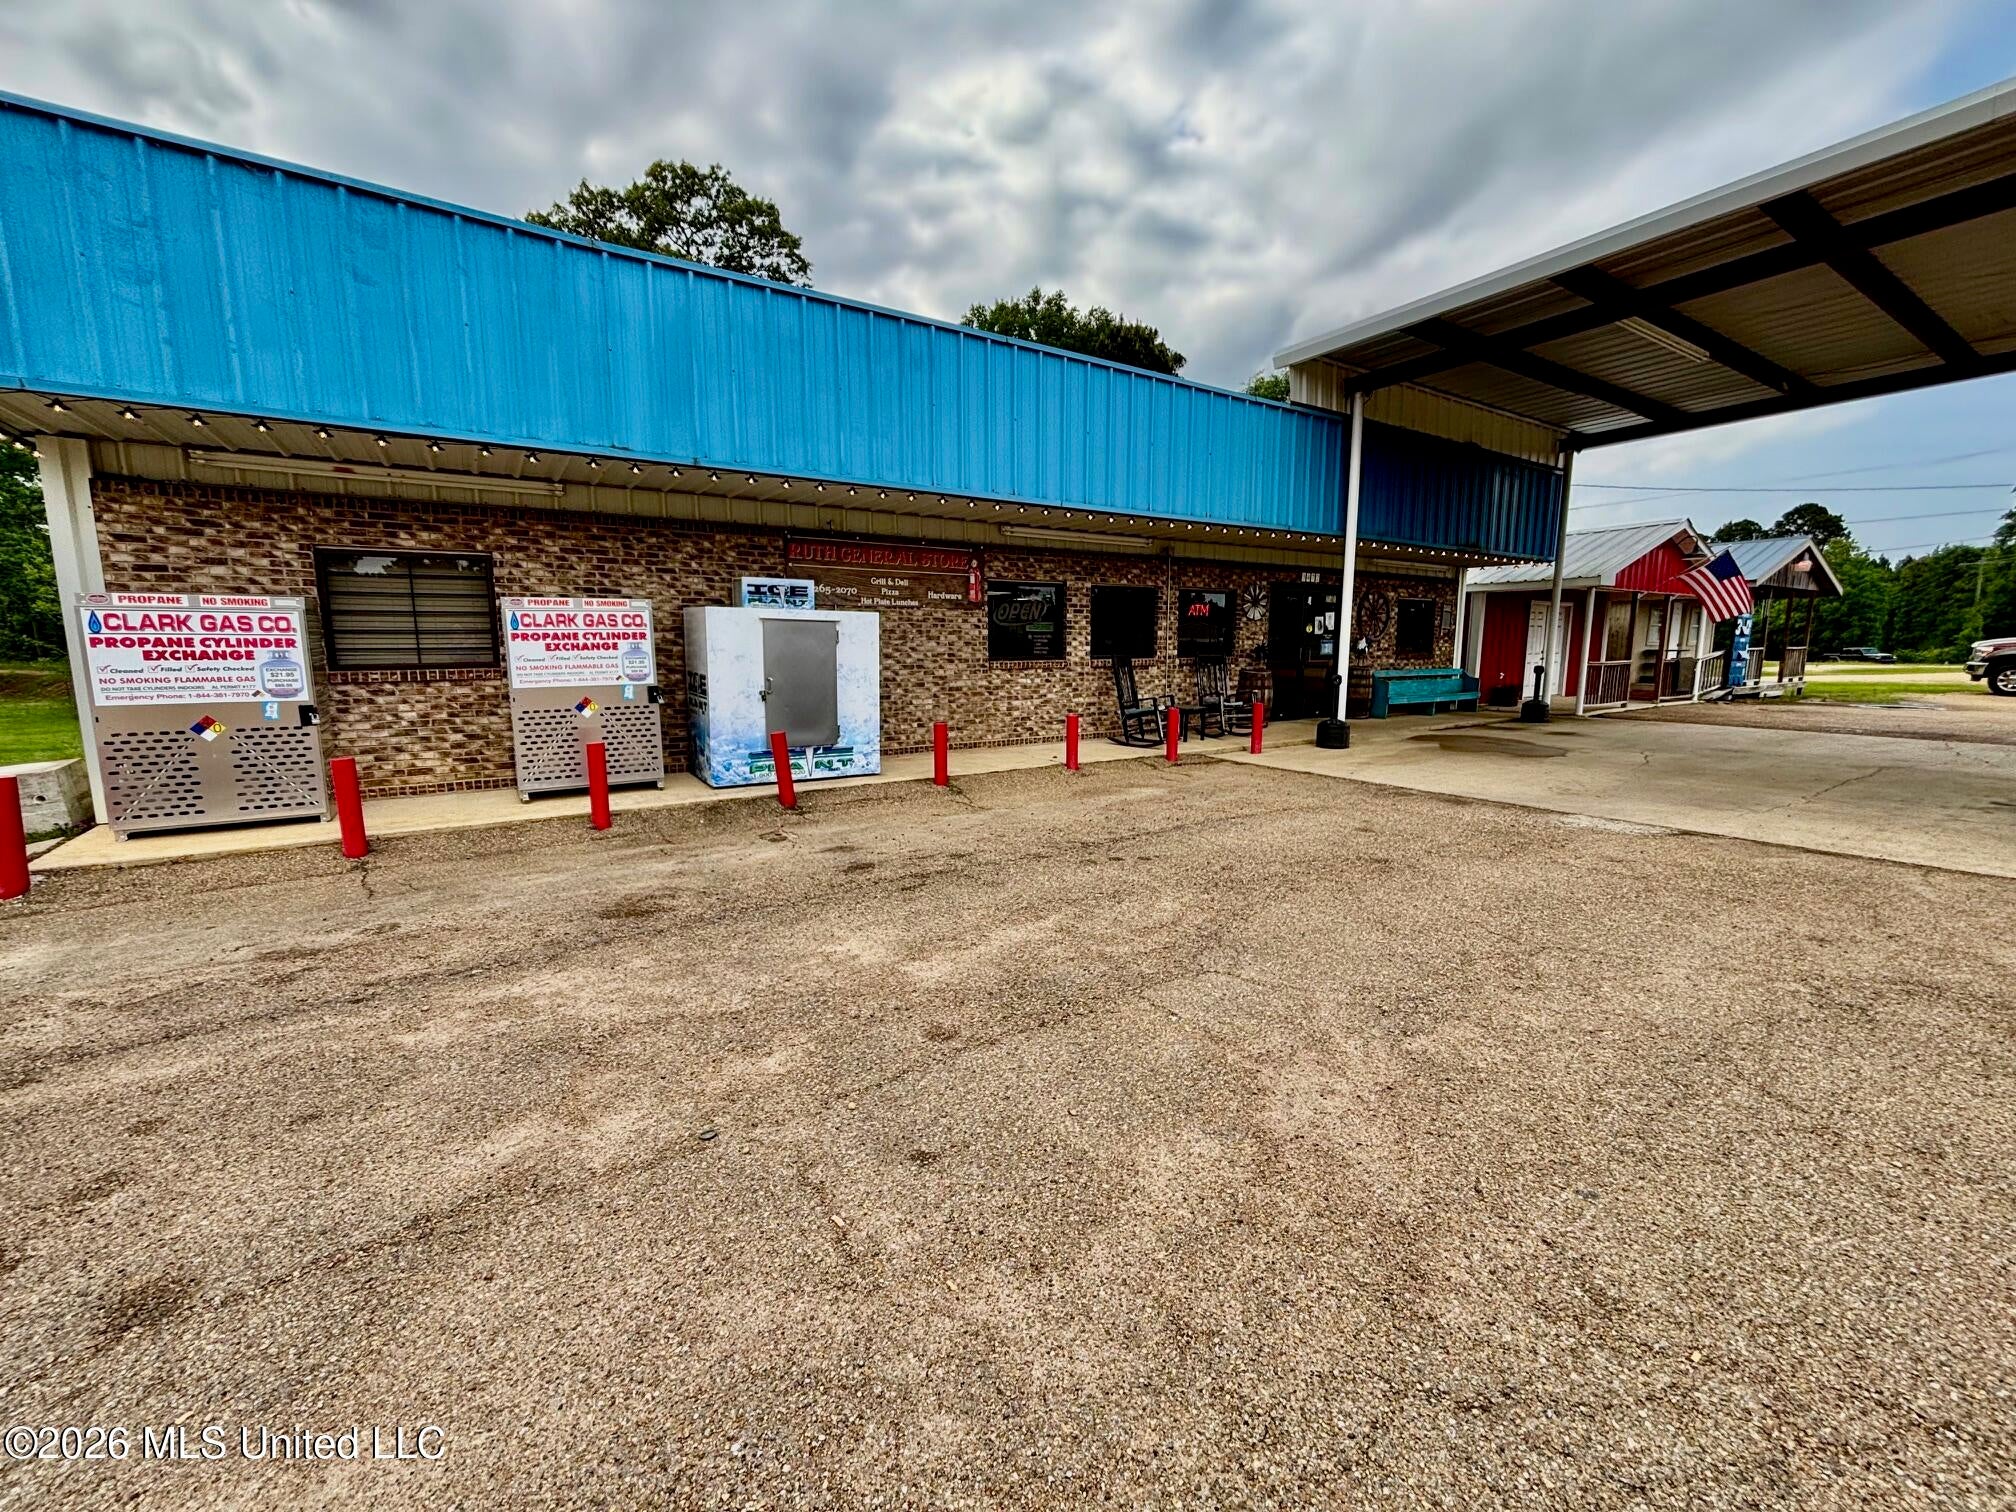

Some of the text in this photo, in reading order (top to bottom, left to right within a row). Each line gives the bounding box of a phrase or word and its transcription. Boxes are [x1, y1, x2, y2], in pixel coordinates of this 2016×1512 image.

[789, 543, 969, 570] RUTH GENERAL STORE
[870, 577, 886, 586] Grill
[887, 578, 894, 586] &
[747, 584, 809, 597] ICE
[881, 588, 899, 596] Pizza
[928, 591, 962, 600] Hardware
[117, 595, 183, 605] PROPANE
[202, 597, 268, 606] NO SMOKING
[861, 597, 873, 605] Hot
[998, 601, 1042, 620] OPEN
[1188, 604, 1209, 616] ATM
[102, 612, 297, 633] CLARK GAS CO.
[520, 613, 647, 628] CLARK GAS CO.
[510, 632, 647, 641] PROPANE CYLINDER
[89, 637, 297, 648] PROPANE CYLINDER
[545, 642, 619, 651] EXCHANGE
[142, 650, 255, 660] EXCHANGE
